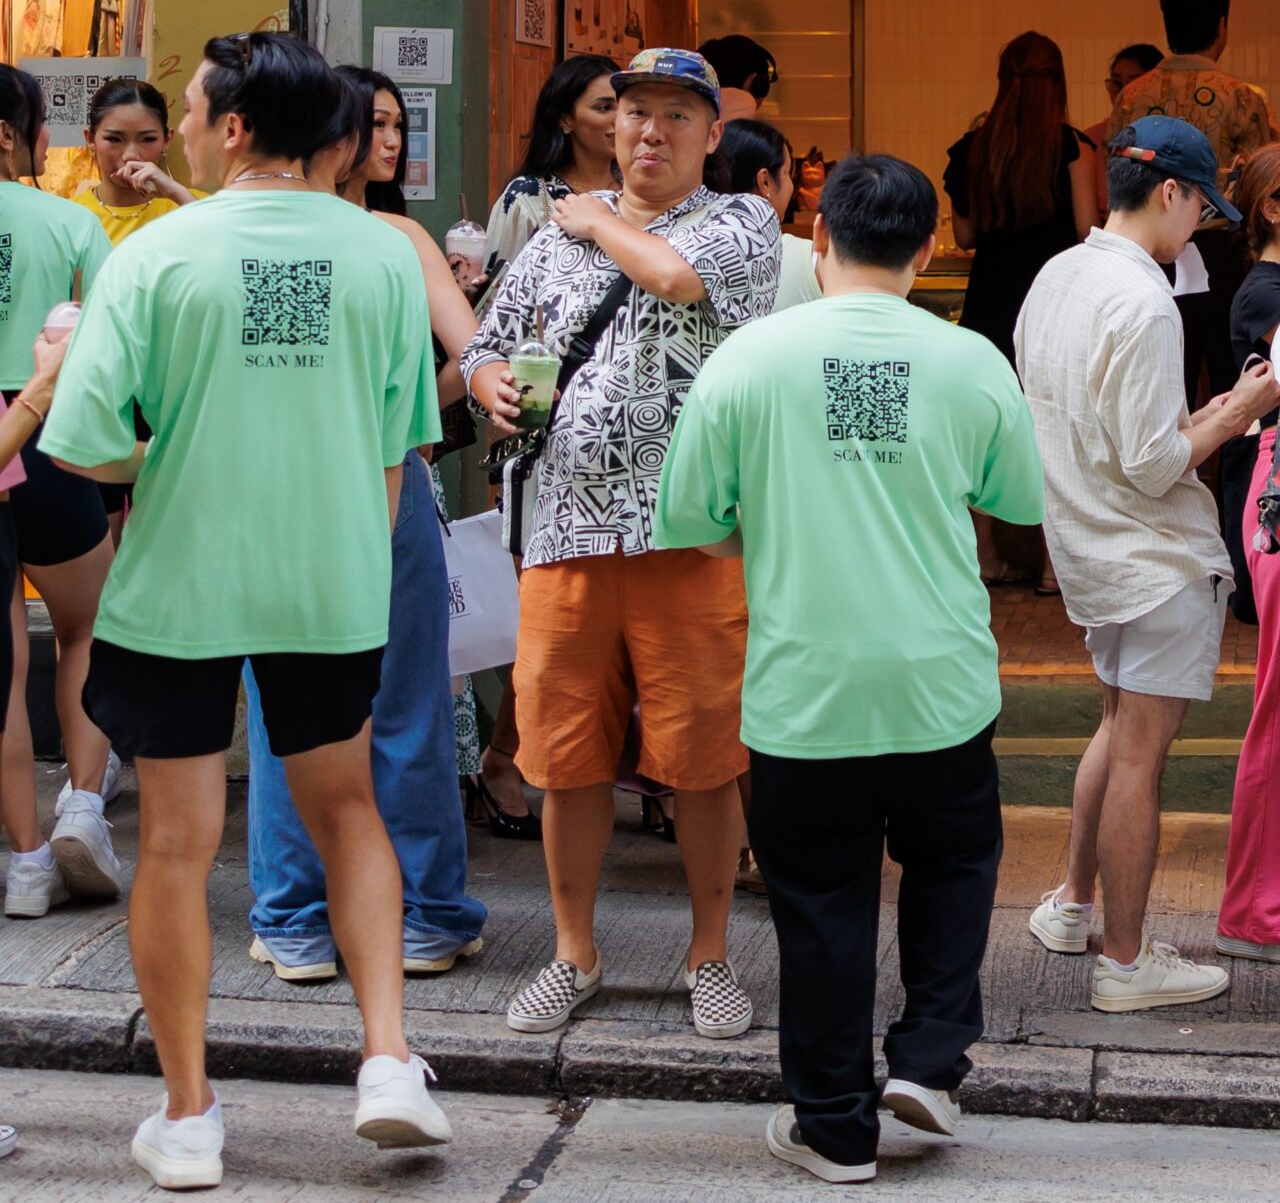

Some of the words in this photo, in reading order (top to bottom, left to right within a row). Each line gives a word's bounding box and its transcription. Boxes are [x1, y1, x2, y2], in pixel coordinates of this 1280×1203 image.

[245, 354, 288, 368] SCAN
[295, 354, 324, 368] ME!
[874, 450, 902, 464] ME!
